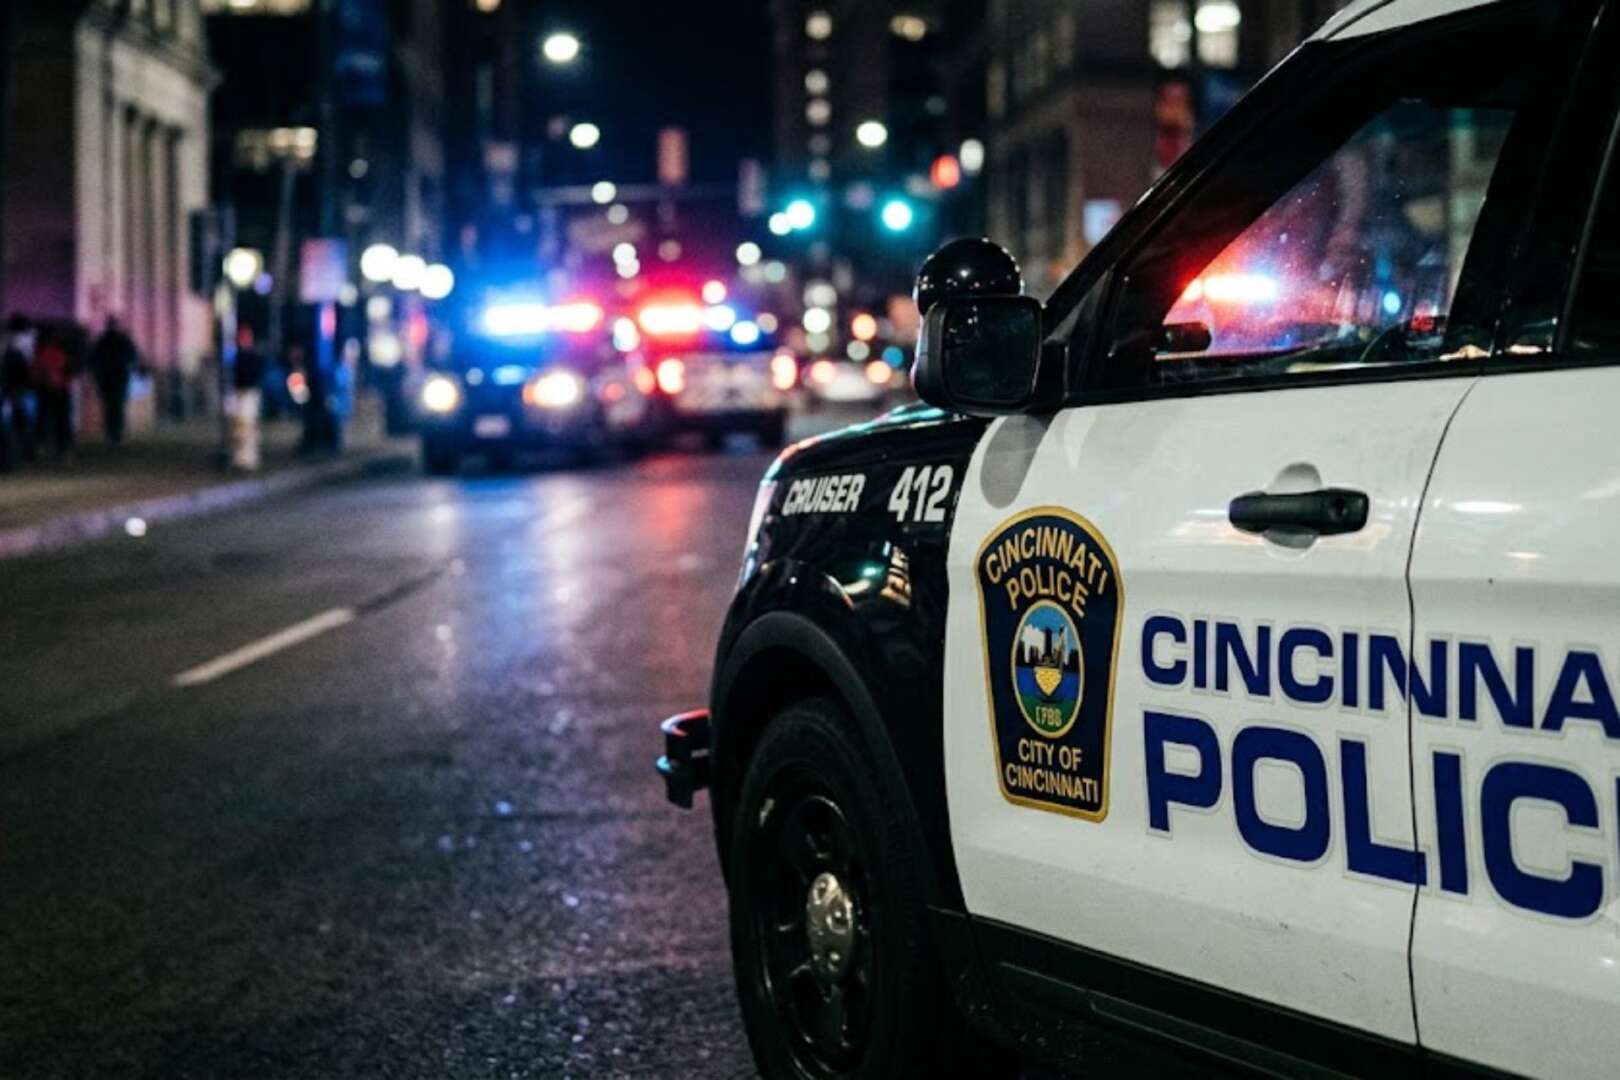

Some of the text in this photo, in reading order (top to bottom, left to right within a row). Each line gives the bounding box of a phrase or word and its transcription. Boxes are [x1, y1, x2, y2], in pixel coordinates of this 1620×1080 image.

[782, 465, 954, 522] CRUISER 412
[986, 526, 1107, 594] CINCINNATI
[1007, 564, 1088, 617] POLICE
[1141, 615, 1620, 739] CINCINNA
[1006, 763, 1099, 803] CINCINNATI
[1018, 738, 1082, 771] CITY OF
[1143, 710, 1620, 918] POLIC
